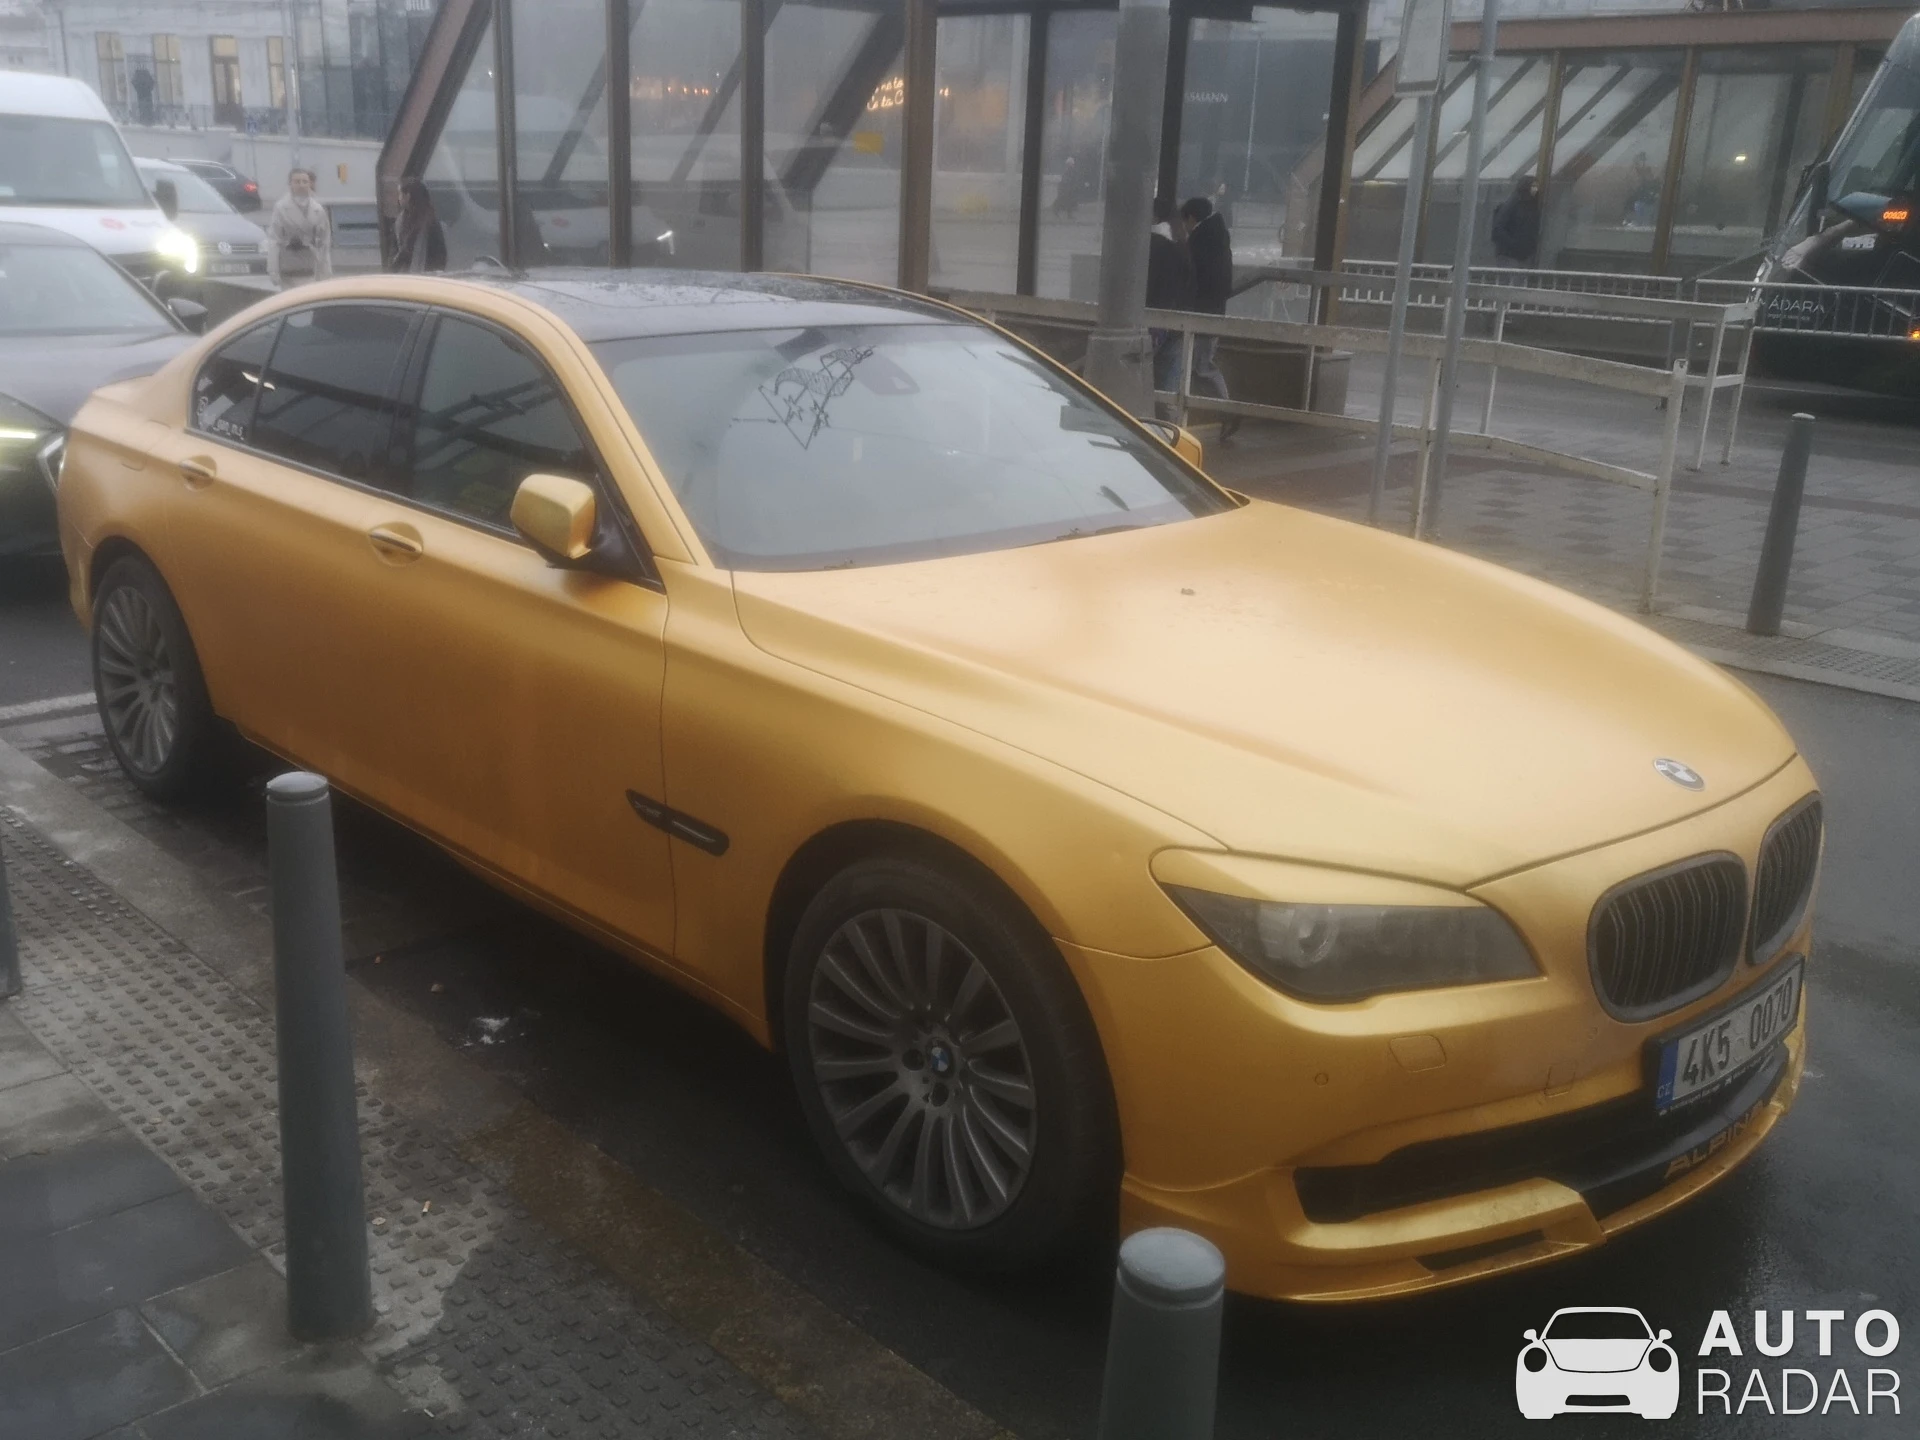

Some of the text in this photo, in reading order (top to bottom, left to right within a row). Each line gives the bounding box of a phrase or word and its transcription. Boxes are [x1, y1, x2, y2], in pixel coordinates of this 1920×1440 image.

[1682, 1020, 1731, 1086] 4K5
[1750, 977, 1793, 1049] 0070
[1657, 1082, 1673, 1098] CZ
